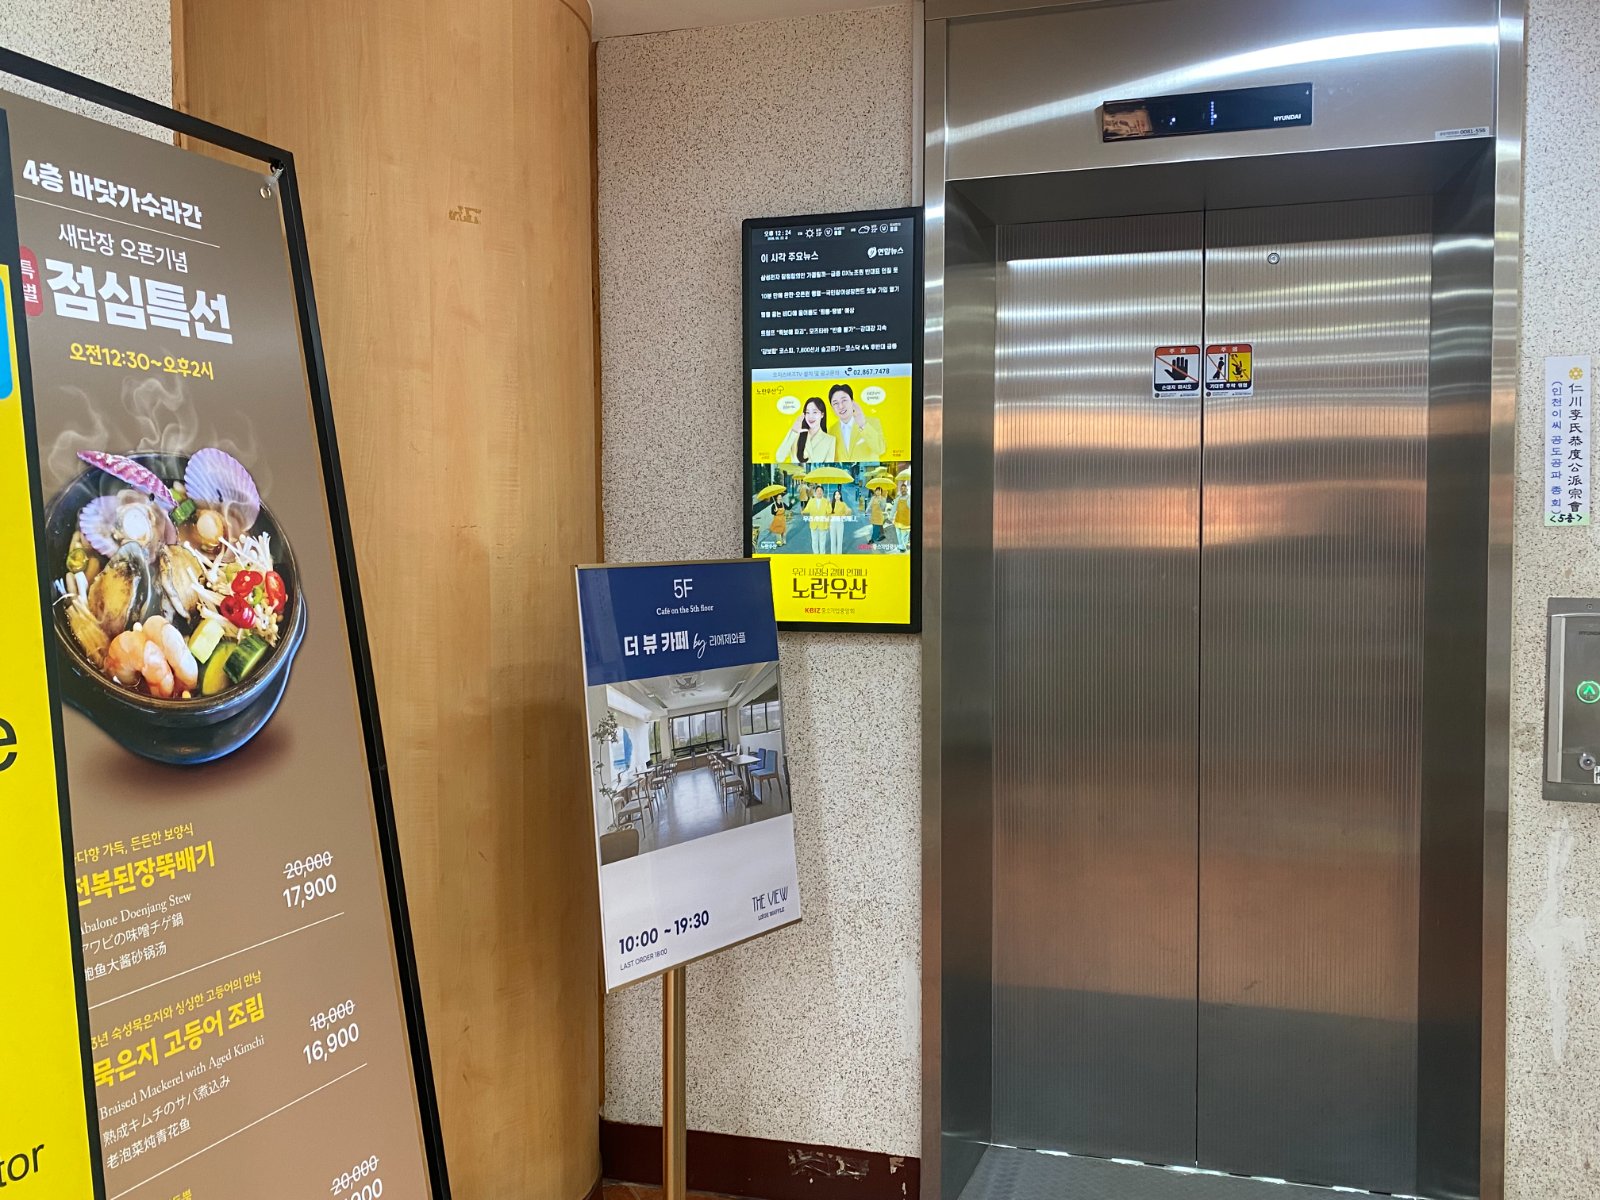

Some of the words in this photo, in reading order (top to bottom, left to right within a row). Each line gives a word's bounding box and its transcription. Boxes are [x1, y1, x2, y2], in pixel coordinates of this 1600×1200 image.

[1273, 113, 1302, 122] HYUNDAI
[22, 160, 63, 192] 4층
[69, 170, 202, 229] 바닷가수라간
[58, 223, 114, 256] 새단장
[120, 238, 188, 273] 오픈기념
[760, 253, 769, 263] 이
[770, 252, 787, 263] 시각
[788, 250, 819, 262] 주요뉴스
[45, 258, 233, 345] 점심특선
[69, 342, 214, 381] 오전12:30~오후2시
[673, 578, 693, 599] 5F
[792, 577, 868, 600] 노란우산
[656, 606, 671, 616] Café
[671, 607, 679, 615] on
[679, 605, 689, 614] the
[689, 604, 700, 613] 5th
[700, 603, 714, 613] floor
[624, 635, 639, 657] 더
[643, 633, 658, 656] 뷰
[661, 630, 689, 652] 카페
[692, 632, 708, 660] by
[130, 831, 162, 851] 든든한
[164, 822, 195, 843] 보양식
[282, 850, 334, 879] 20,000
[120, 900, 168, 923] Doenjang
[169, 892, 192, 908] Stew
[282, 874, 337, 909] 17,900
[752, 893, 766, 913] THE
[767, 886, 789, 907] VIEW
[618, 927, 659, 955] 10:00
[674, 909, 710, 936] 19:30
[620, 958, 634, 971] LAST
[635, 953, 655, 966] ORDER
[111, 1008, 174, 1041] 숙성묵은지와
[175, 994, 205, 1015] 싱싱한
[206, 977, 243, 1002] 고등어의
[244, 970, 262, 987] 만남
[309, 999, 356, 1032] 18,000
[94, 1038, 159, 1087] 묵은지
[164, 1010, 224, 1058] 고등어
[228, 993, 265, 1030] 조림
[303, 1022, 360, 1065] 16,900
[99, 1092, 139, 1120] Braised
[140, 1073, 185, 1105] Mackerel
[186, 1060, 207, 1079] with
[208, 1048, 232, 1070] Aged
[233, 1034, 265, 1058] Kimchi
[330, 1155, 379, 1196] 20,000
